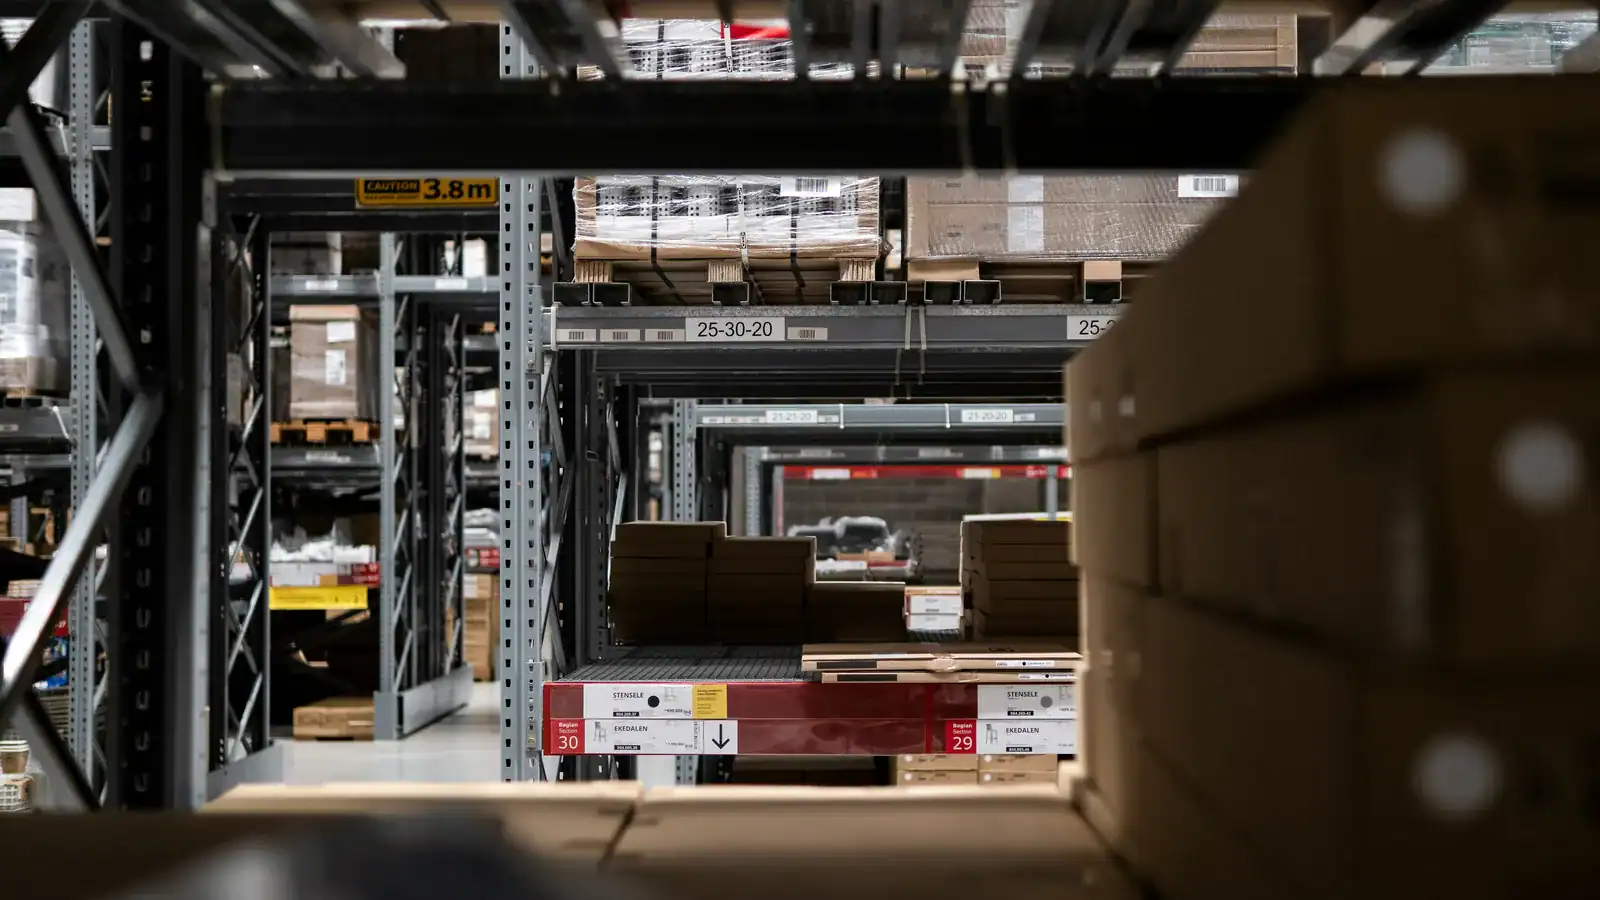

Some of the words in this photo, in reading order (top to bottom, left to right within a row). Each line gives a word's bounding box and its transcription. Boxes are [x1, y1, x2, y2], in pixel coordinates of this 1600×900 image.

[366, 181, 418, 191] CAUTION
[697, 321, 773, 337] 25-30-20
[1079, 319, 1117, 335] 25-
[771, 412, 812, 421] 21-21-20
[967, 411, 1008, 421] 21-20-20
[558, 735, 578, 750] 30
[952, 736, 973, 750] 29
